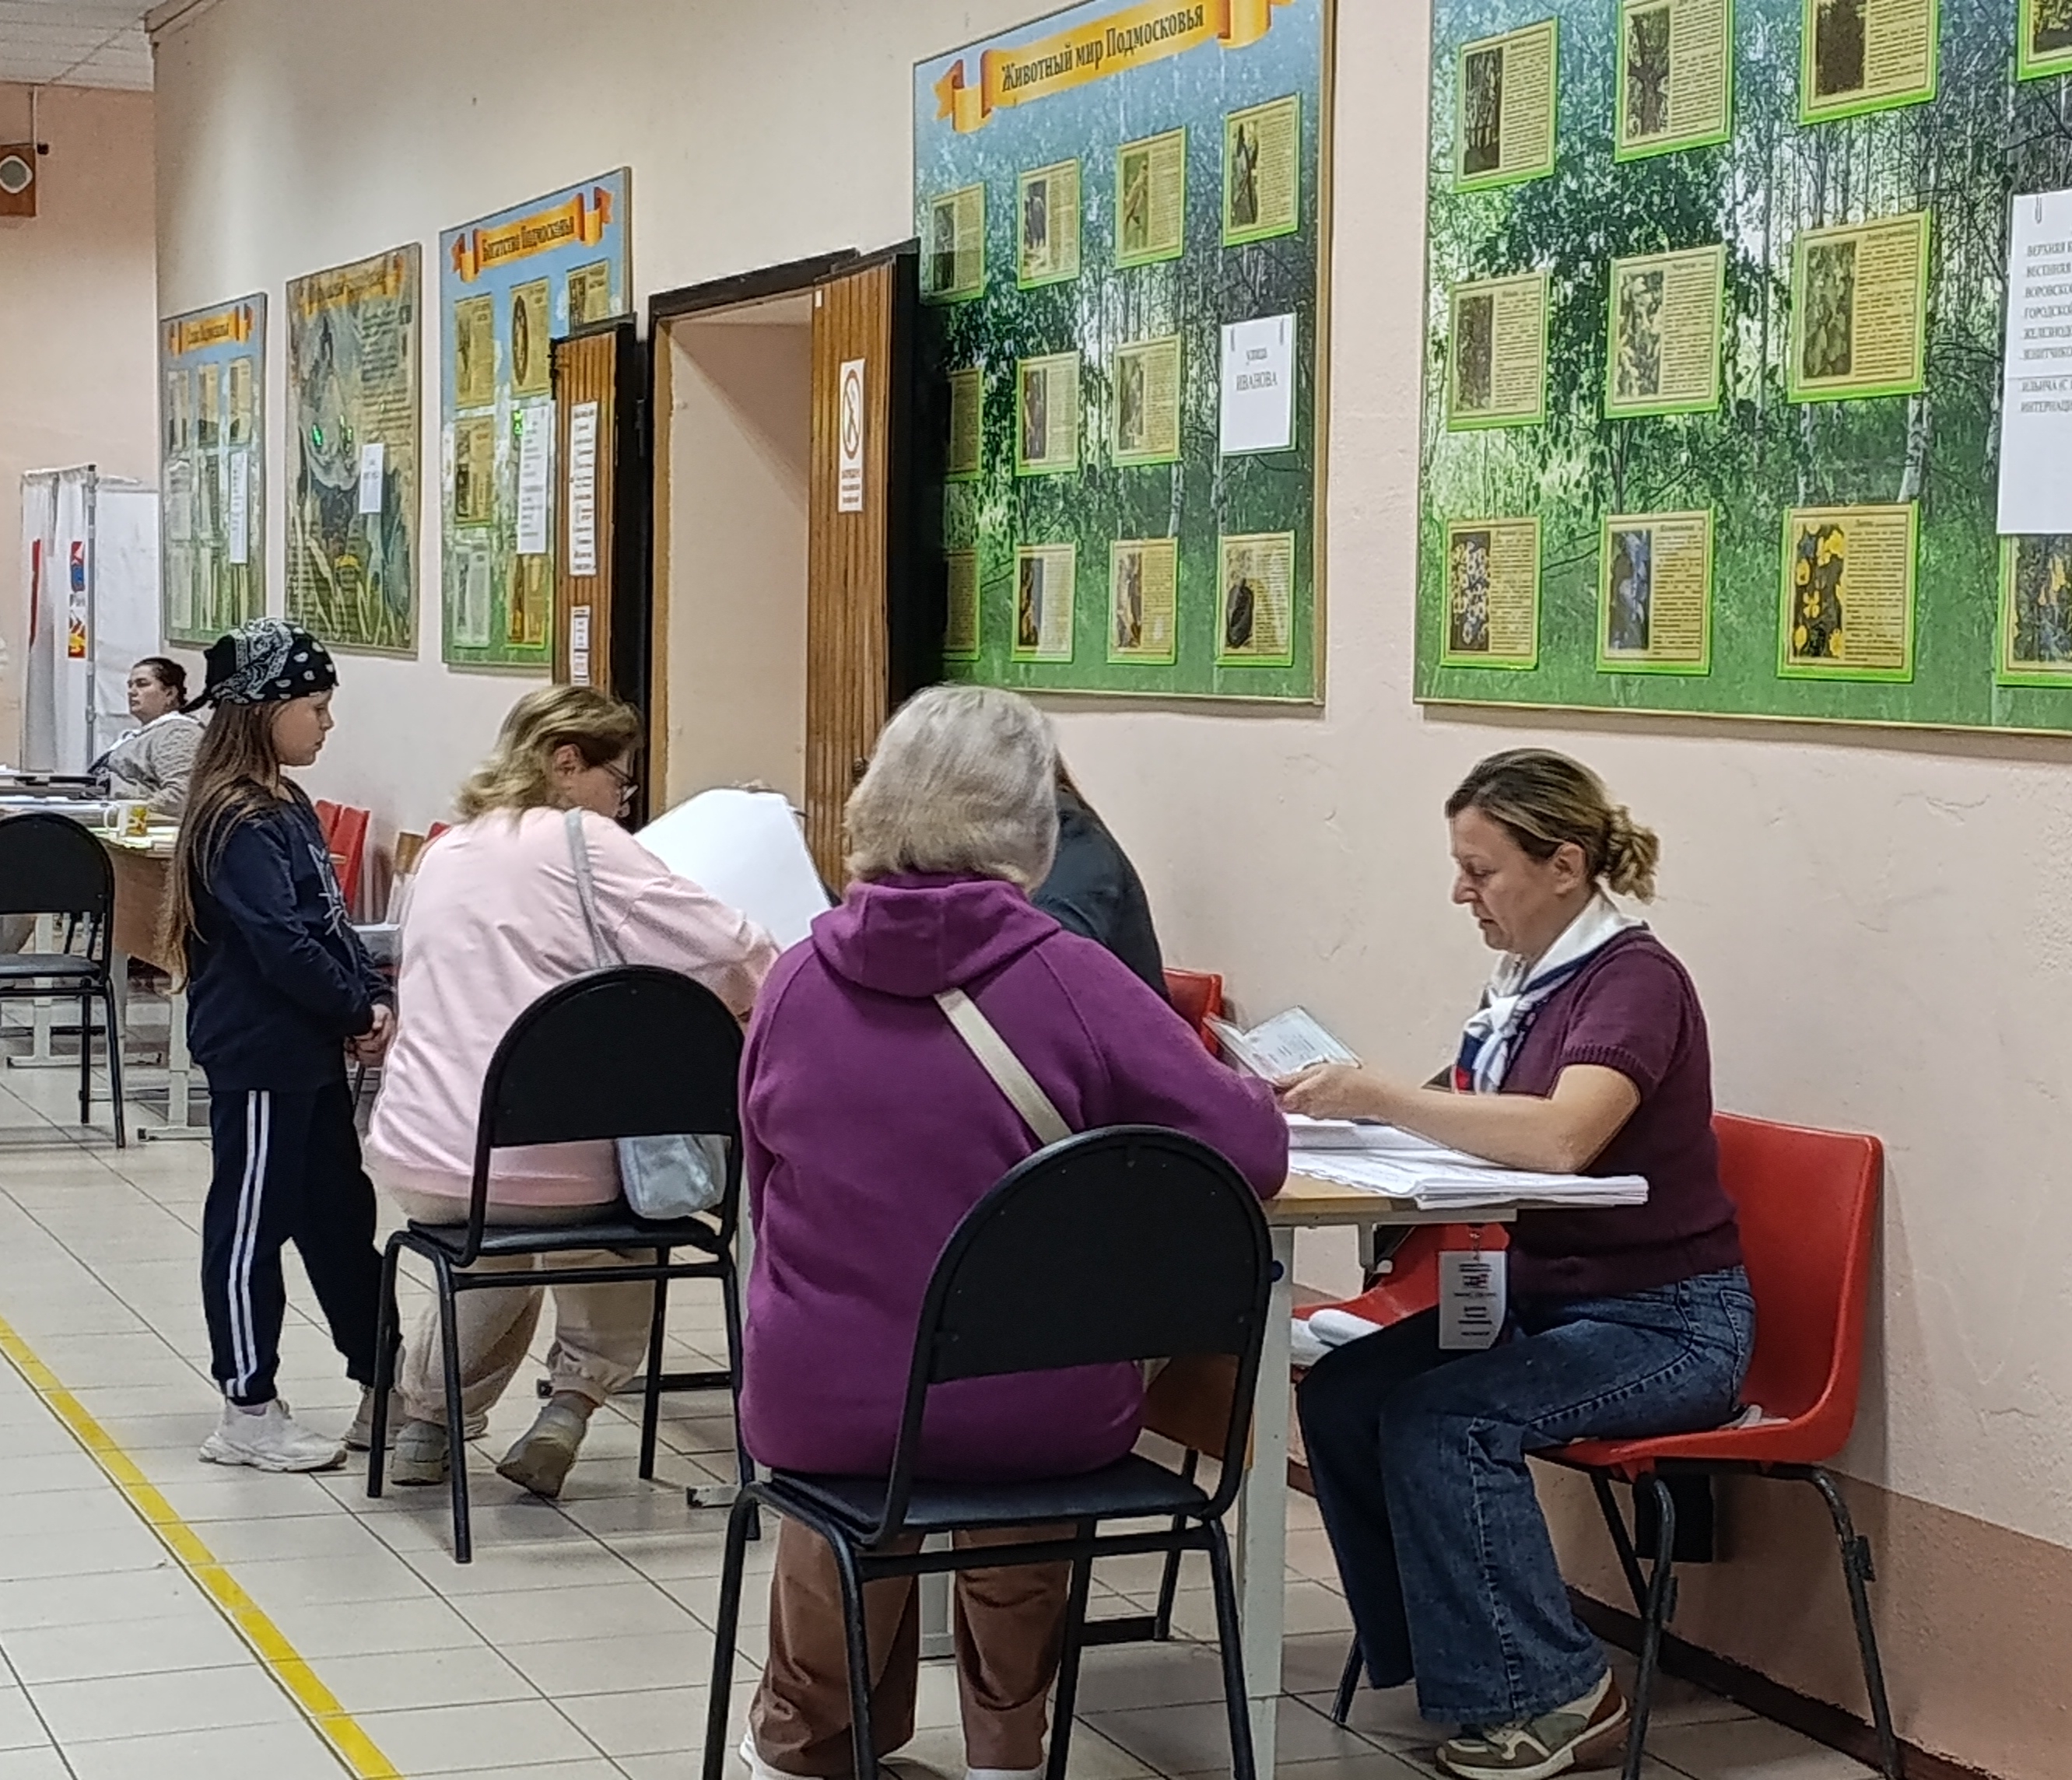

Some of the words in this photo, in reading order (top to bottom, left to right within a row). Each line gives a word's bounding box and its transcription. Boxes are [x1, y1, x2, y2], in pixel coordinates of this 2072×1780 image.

[1001, 42, 1073, 93] Животный
[1075, 40, 1103, 70] мир
[1105, 4, 1204, 58] Подмосковья
[1236, 371, 1278, 391] ИВАНОВА
